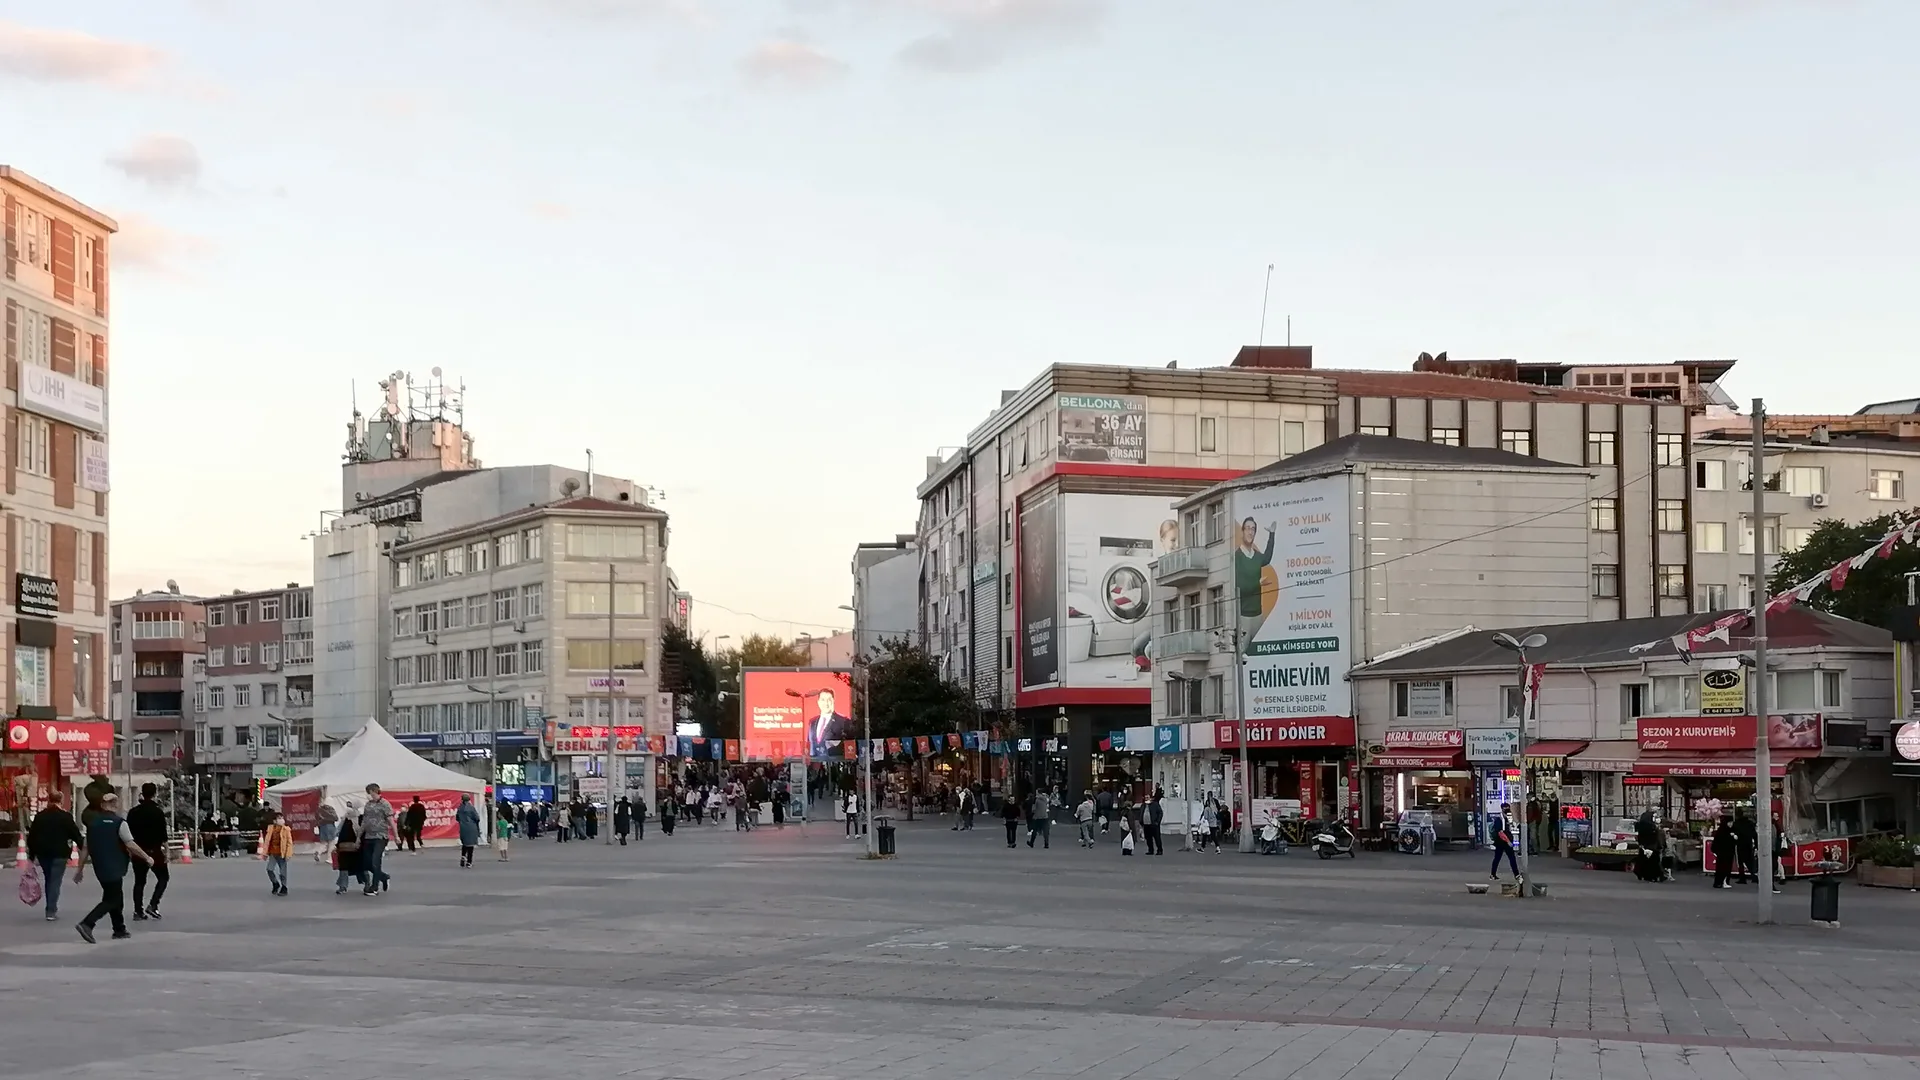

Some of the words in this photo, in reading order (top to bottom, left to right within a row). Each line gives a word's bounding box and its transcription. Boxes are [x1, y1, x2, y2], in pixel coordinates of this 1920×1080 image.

[1059, 396, 1122, 409] BELLONA
[1101, 414, 1120, 430] 36
[1124, 414, 1143, 431] AY
[1115, 435, 1143, 446] TAKSİT
[1110, 449, 1144, 459] FIRSATI!
[1282, 496, 1324, 506] eminevim.com
[1288, 516, 1300, 527] 30
[1302, 512, 1332, 525] YILLIK
[1286, 555, 1322, 569] 180.000
[1289, 612, 1294, 621] 1
[1296, 608, 1332, 620] MİLYON
[1257, 643, 1281, 654] BAŞKA
[1282, 641, 1316, 651] KİMSEDE
[1249, 662, 1330, 689] EMİNEVİM
[1264, 695, 1295, 704] ESENLER
[1296, 693, 1327, 704] ŞUBEMİZ
[1253, 706, 1261, 715] 50
[1262, 706, 1286, 714] METRE
[58, 729, 91, 742] vodafone
[1237, 722, 1272, 742] İĞİT
[1278, 722, 1326, 740] DÖNER
[1390, 732, 1410, 741] KRAL
[1412, 730, 1449, 742] KOKOREÇ
[1642, 728, 1673, 737] SEZON
[1674, 728, 1681, 736] 2
[1682, 726, 1736, 738] KURUYEMİŞ
[1642, 740, 1670, 749] Coca-Cola
[1492, 748, 1510, 756] SERVİS
[1380, 758, 1395, 766] KRAL
[1396, 758, 1424, 767] KOKOREÇ
[1700, 768, 1747, 776] KURUYEMİŞ
